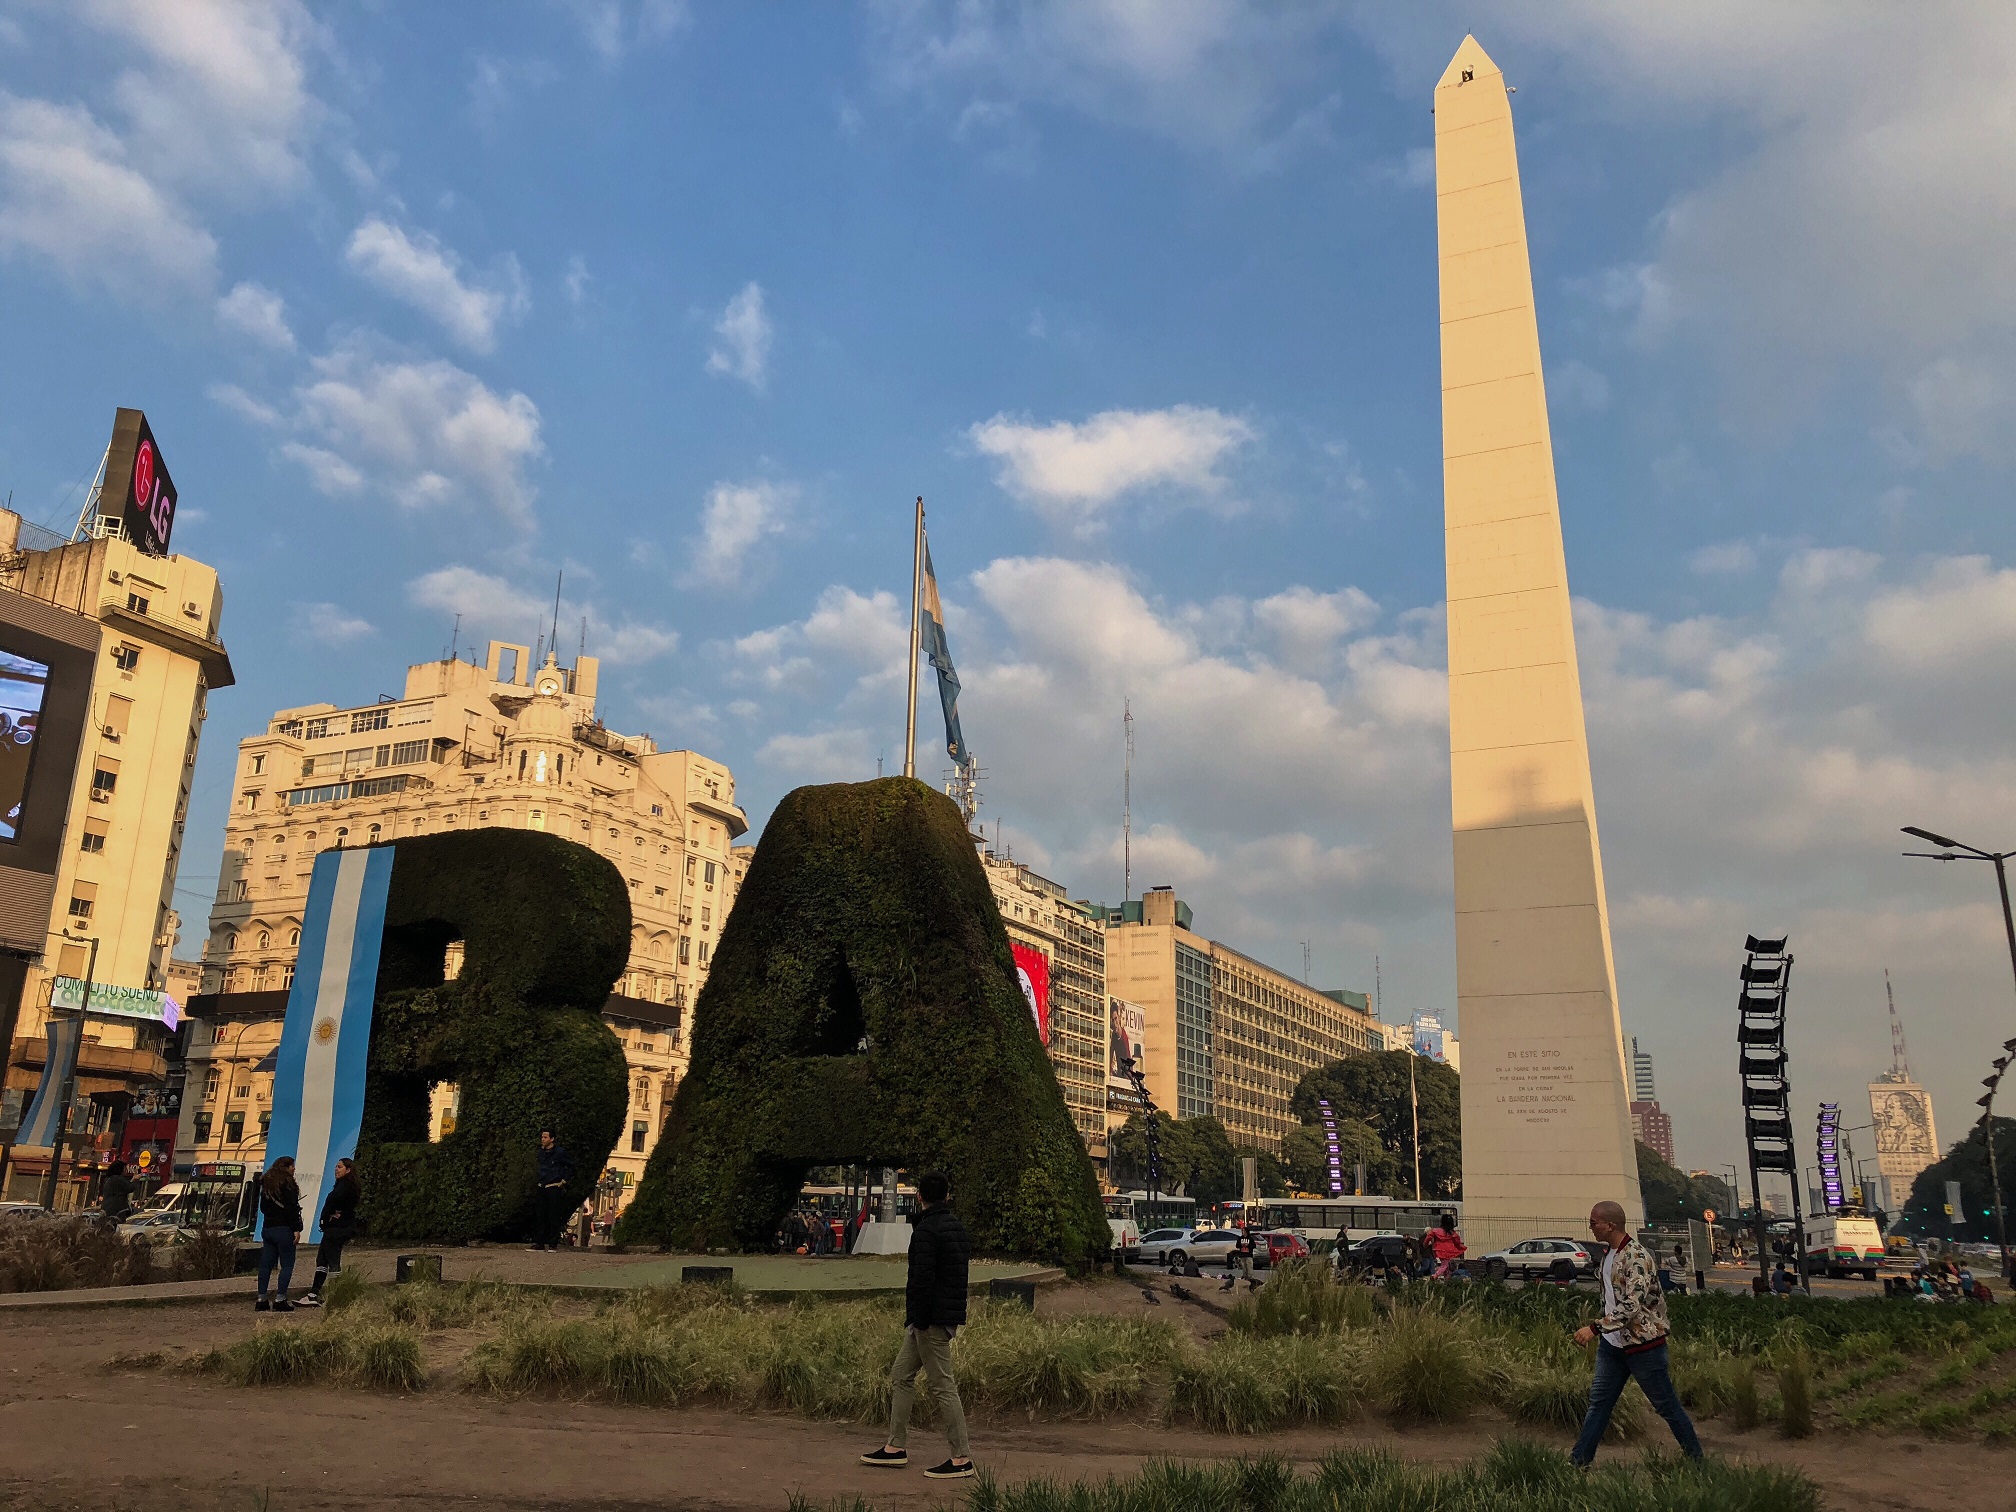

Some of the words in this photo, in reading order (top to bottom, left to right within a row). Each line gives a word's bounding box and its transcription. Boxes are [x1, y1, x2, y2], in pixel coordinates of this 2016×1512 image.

[150, 477, 171, 544] LG
[1125, 1009, 1145, 1032] KEVIN
[1507, 1051, 1517, 1059] EN
[1520, 1050, 1538, 1058] ESTE
[1541, 1050, 1561, 1058] SITIO
[1508, 1095, 1539, 1103] BANDERA
[1541, 1094, 1576, 1102] NACIONAL
